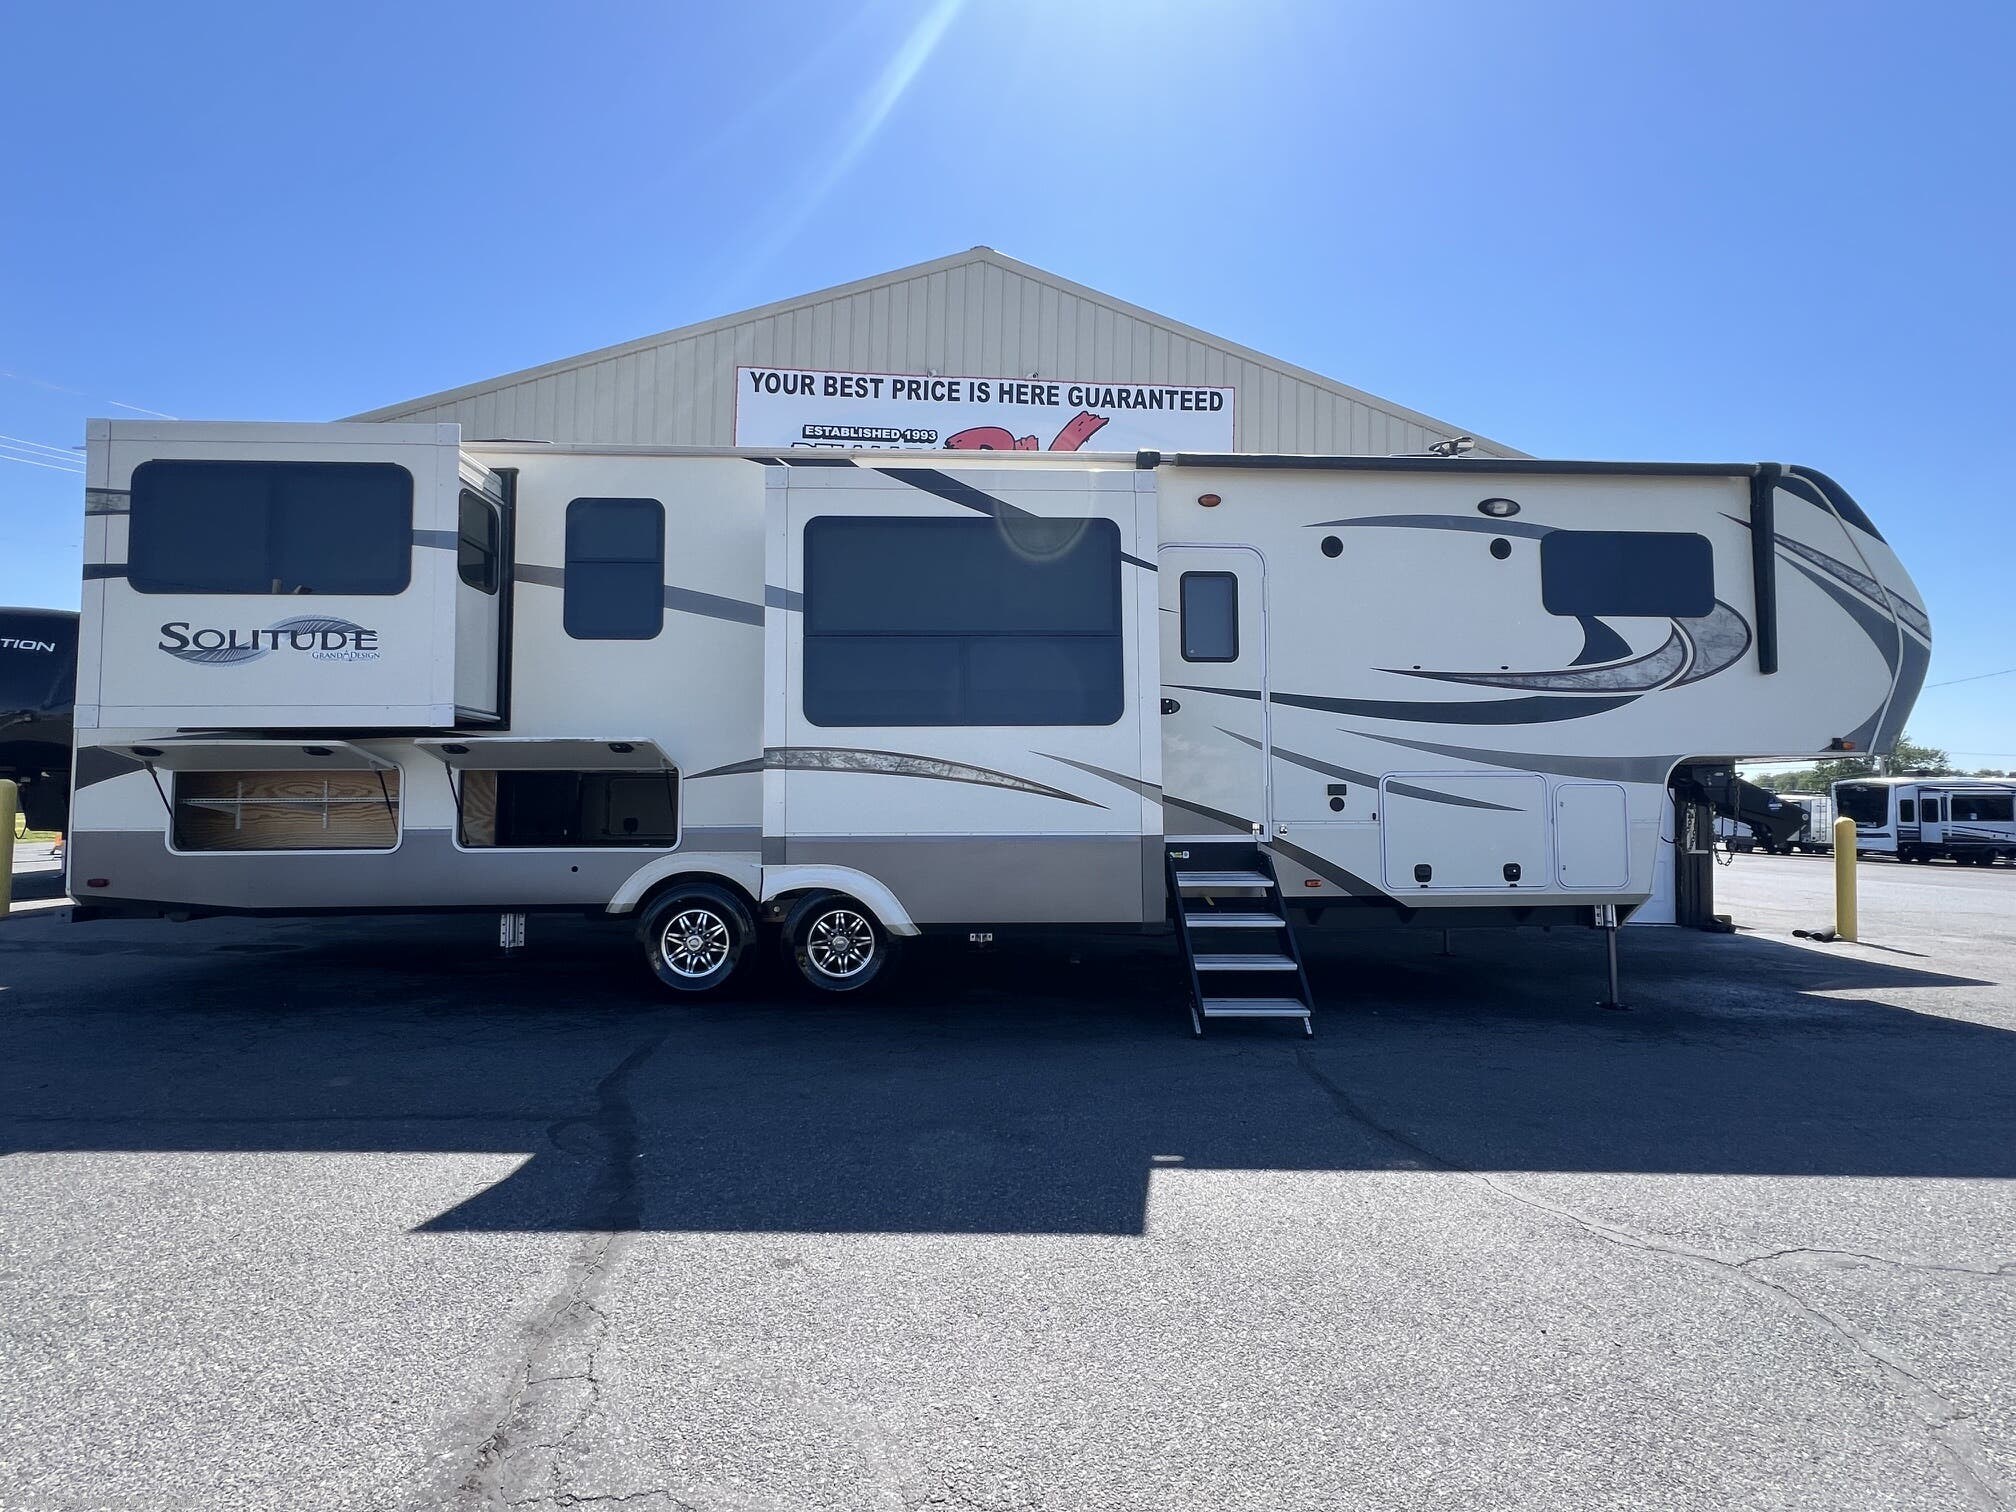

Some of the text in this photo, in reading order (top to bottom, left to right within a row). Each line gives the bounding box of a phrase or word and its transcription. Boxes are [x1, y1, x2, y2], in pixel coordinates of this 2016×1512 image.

[750, 371, 1224, 412] YOUR BEST PRICE IS HERE GUARANTEED
[804, 425, 937, 441] ESTABLISHED 1993
[158, 622, 379, 651] SOLITUDE
